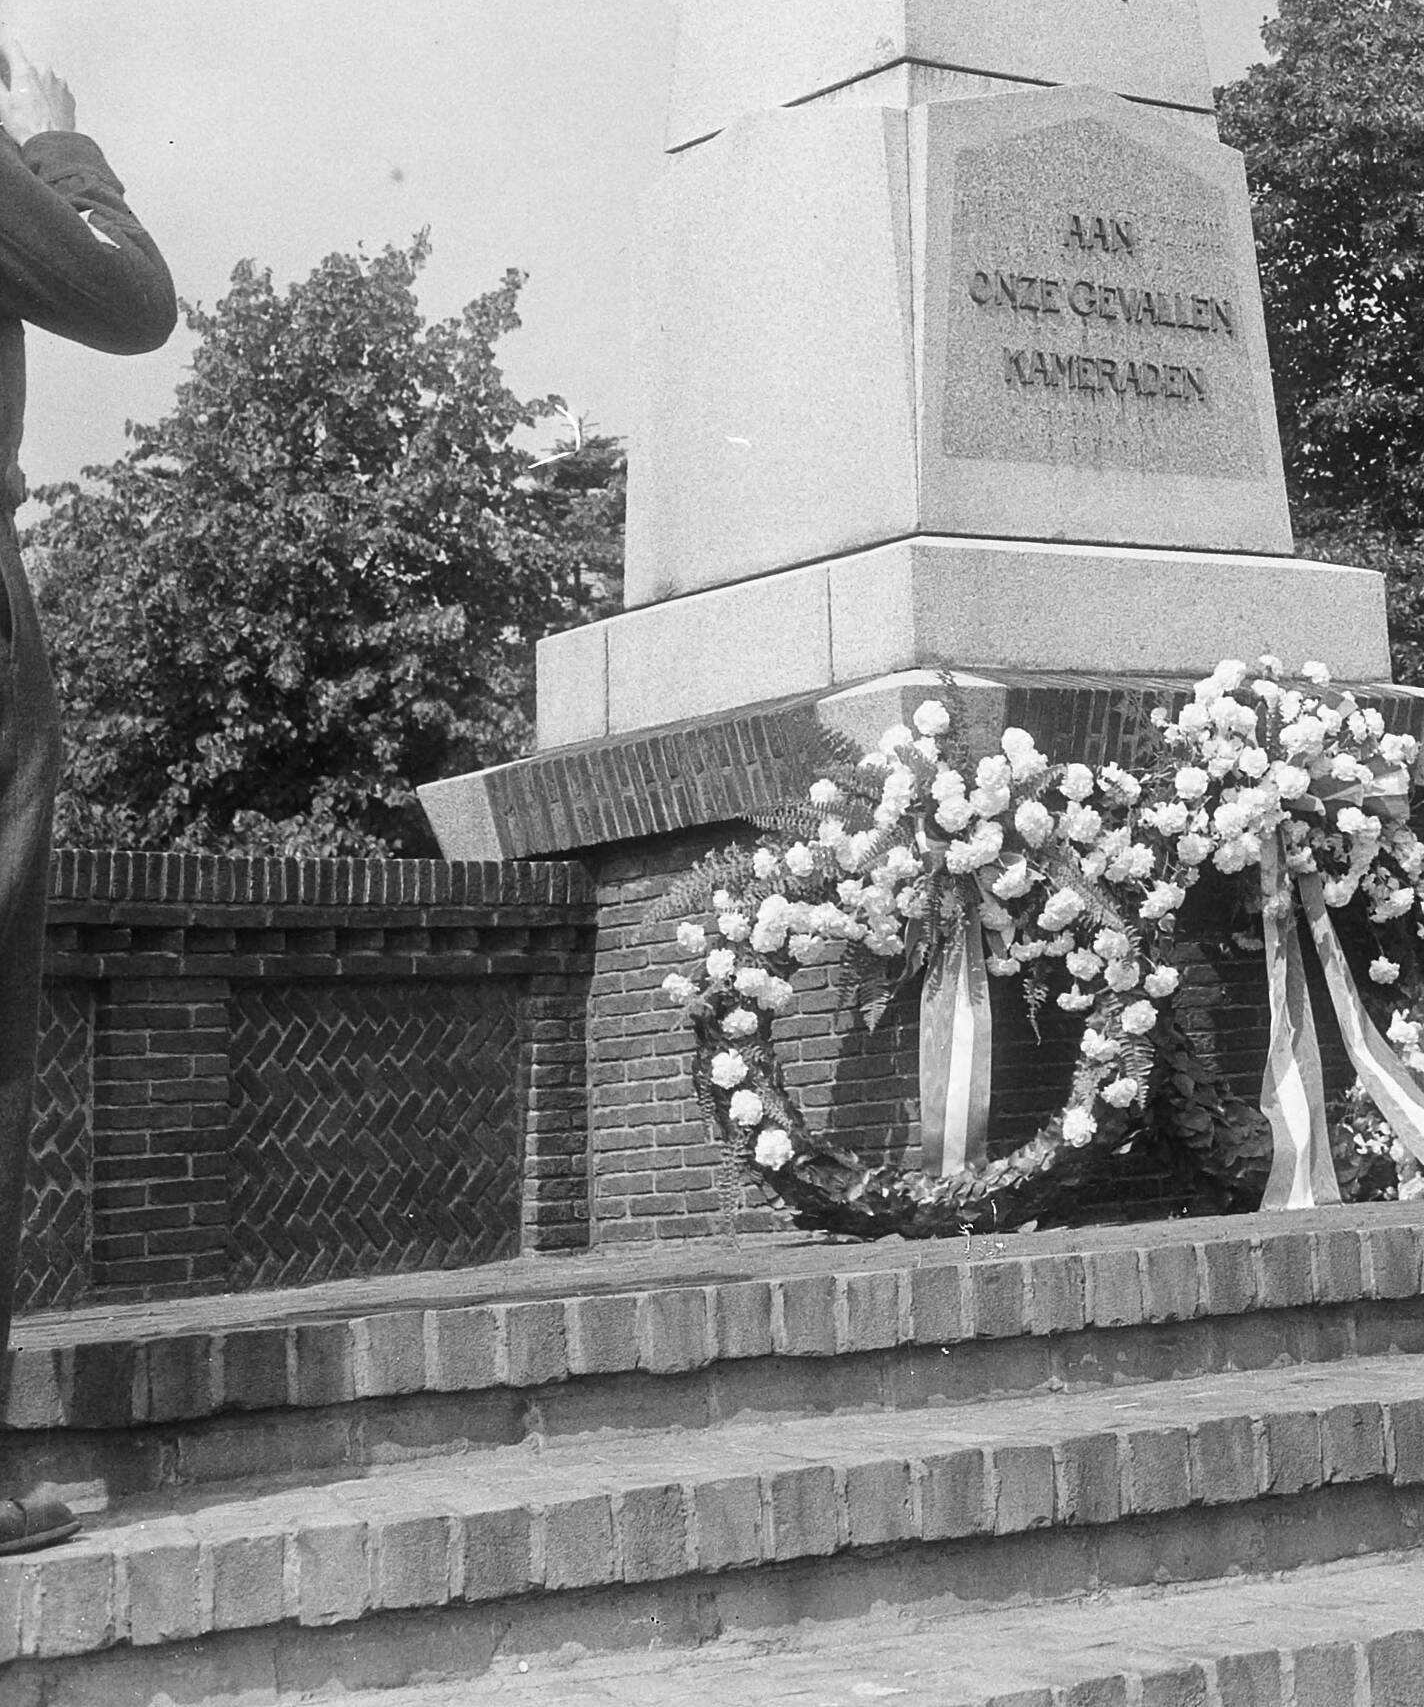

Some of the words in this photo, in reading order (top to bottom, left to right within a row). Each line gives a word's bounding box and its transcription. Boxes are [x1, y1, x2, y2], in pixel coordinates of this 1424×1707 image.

[1063, 214, 1134, 256] AAN
[967, 271, 1060, 314] ONZE
[1069, 281, 1234, 336] GEVALLEN
[1003, 347, 1206, 402] KAMERADEN
